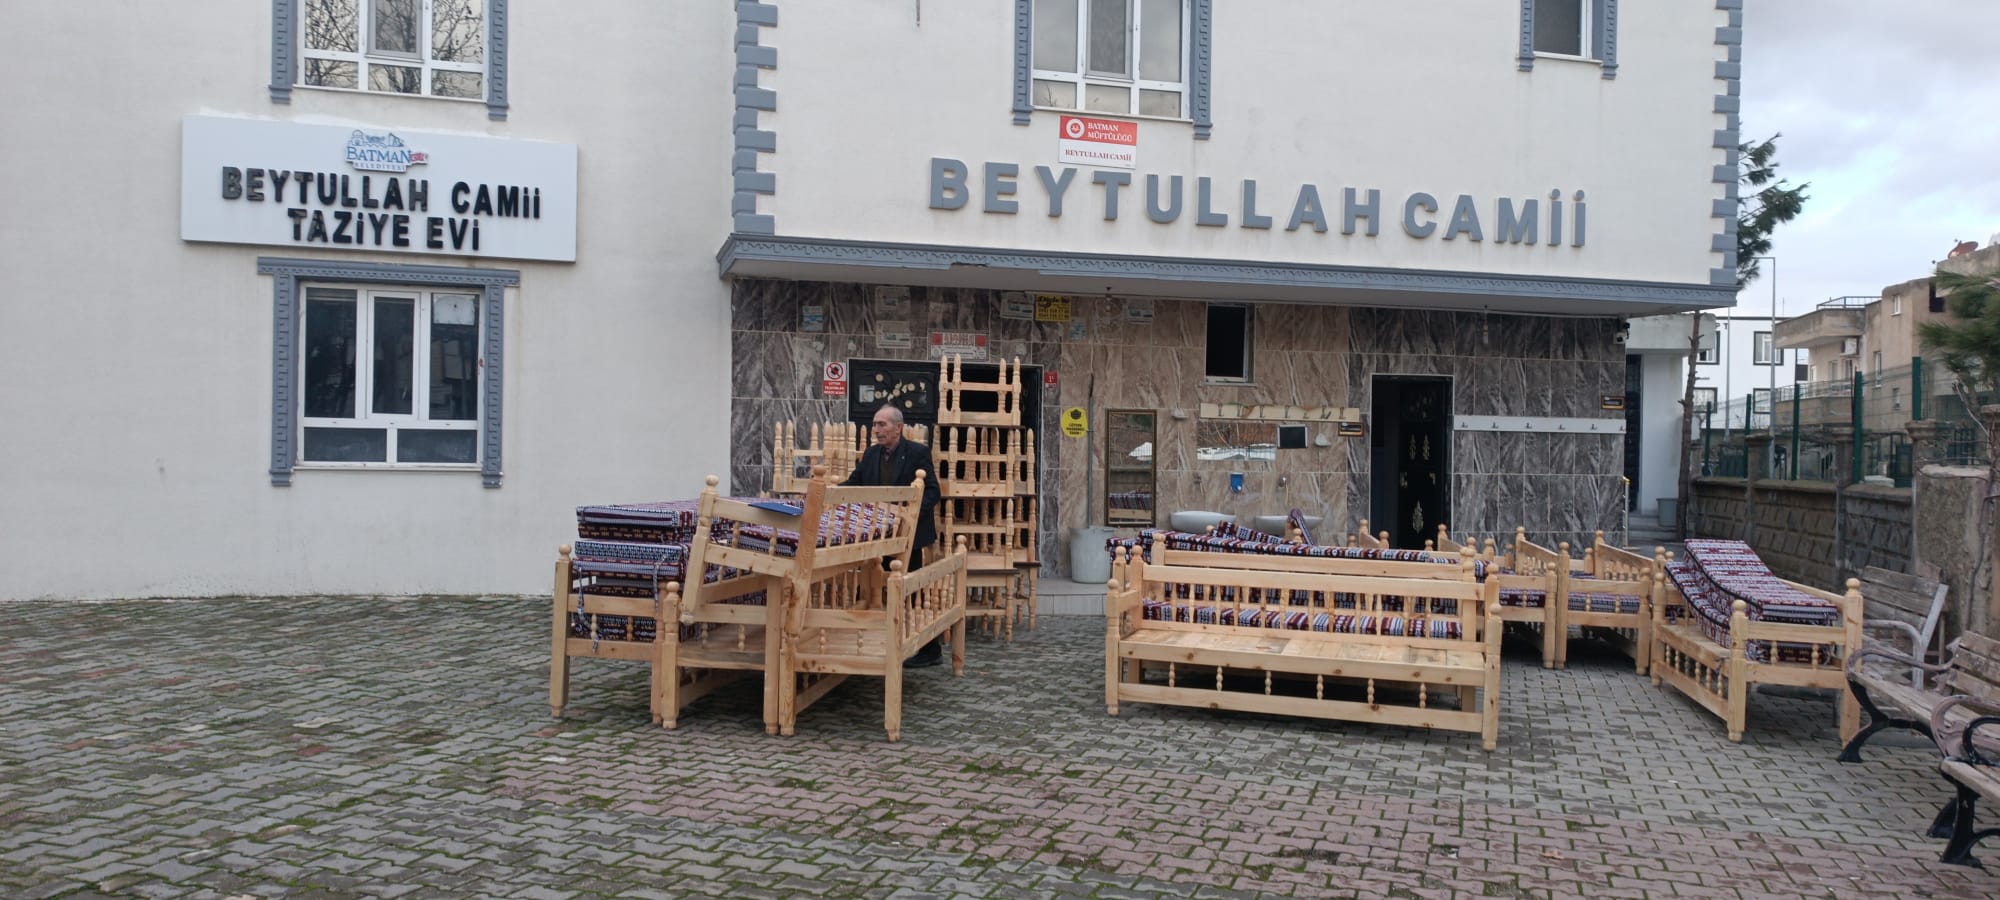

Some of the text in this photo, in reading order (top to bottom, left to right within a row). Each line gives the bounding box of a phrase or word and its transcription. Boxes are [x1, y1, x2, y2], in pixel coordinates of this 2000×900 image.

[1088, 122, 1119, 131] BATMAN
[347, 146, 411, 163] BATMAN
[1065, 149, 1109, 158] BEYTULLAH
[222, 167, 427, 211] BEYTULLAH
[929, 157, 1381, 236] BEYTULLAH
